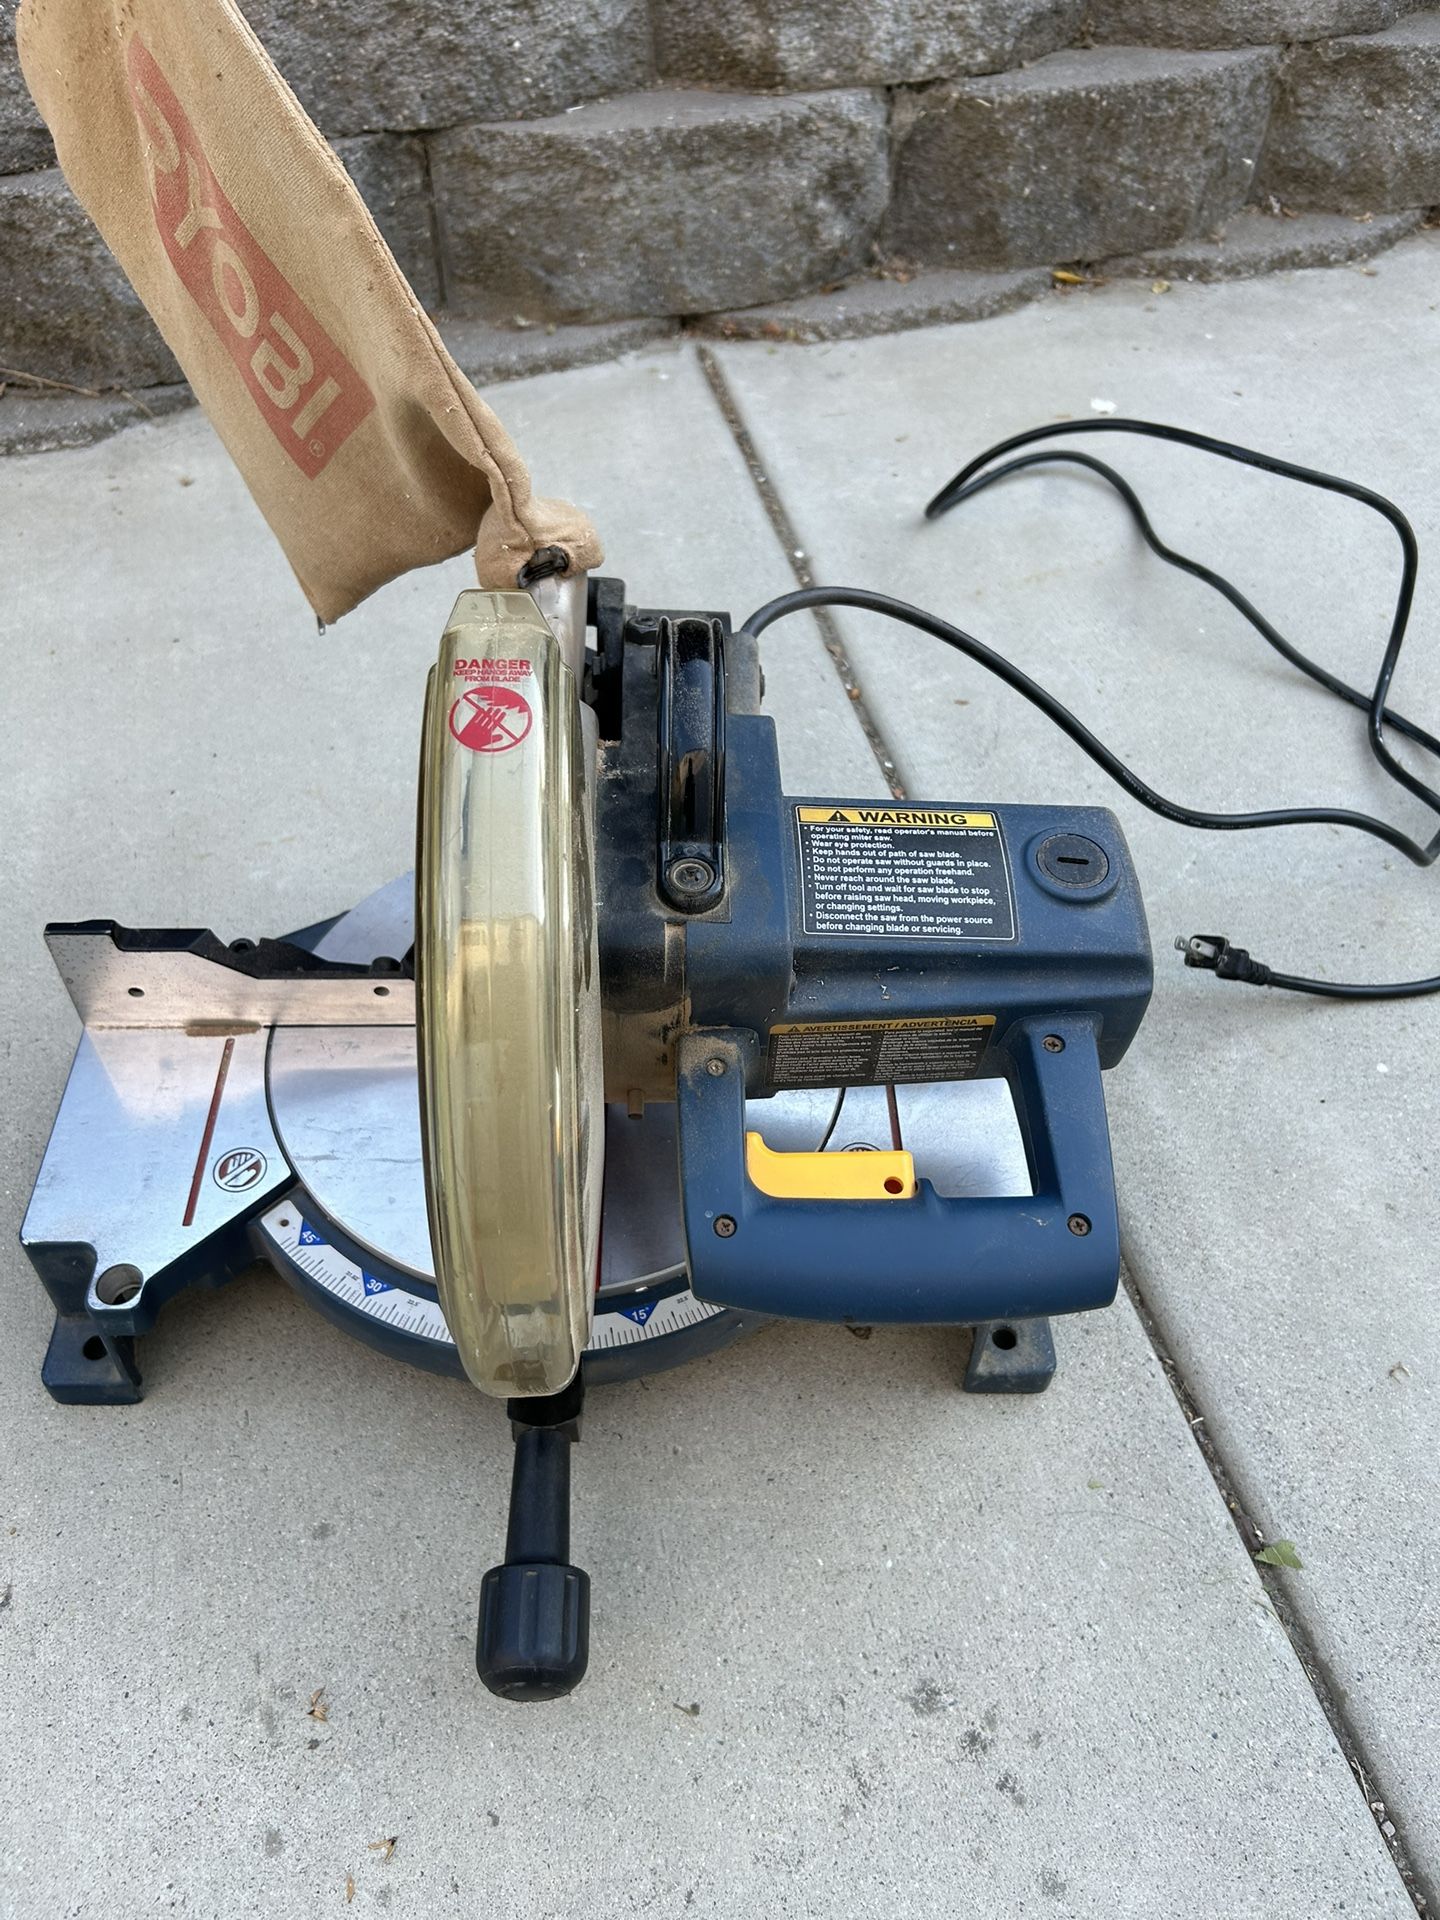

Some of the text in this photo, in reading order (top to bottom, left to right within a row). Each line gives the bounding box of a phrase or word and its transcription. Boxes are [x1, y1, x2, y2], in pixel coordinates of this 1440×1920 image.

[455, 659, 531, 669] DANGER
[858, 811, 967, 825] WARNING
[846, 826, 872, 834] safety,
[894, 828, 935, 836] operator's
[810, 833, 849, 841] operating
[850, 841, 894, 849] protection.
[888, 850, 906, 858] path
[841, 857, 873, 865] operate
[925, 859, 955, 868] guards
[966, 860, 991, 869] place.
[842, 865, 875, 874] perform
[894, 867, 934, 876] operation
[970, 887, 990, 896] stop
[843, 893, 872, 902] raising
[892, 894, 916, 903] head,
[917, 895, 949, 904] moving
[950, 896, 996, 905] workpiece,
[826, 902, 865, 911] changing
[866, 903, 903, 912] settings.
[815, 911, 863, 919] Disconnect
[935, 916, 962, 924] power
[816, 921, 843, 929] before
[844, 922, 884, 932] changing
[885, 923, 909, 931] blade
[921, 924, 963, 934] servicing.
[803, 1022, 893, 1033] AVERTISSEMENT
[301, 1229, 321, 1243] 45°
[366, 1278, 387, 1292] 30°
[631, 1306, 649, 1320] 15°
